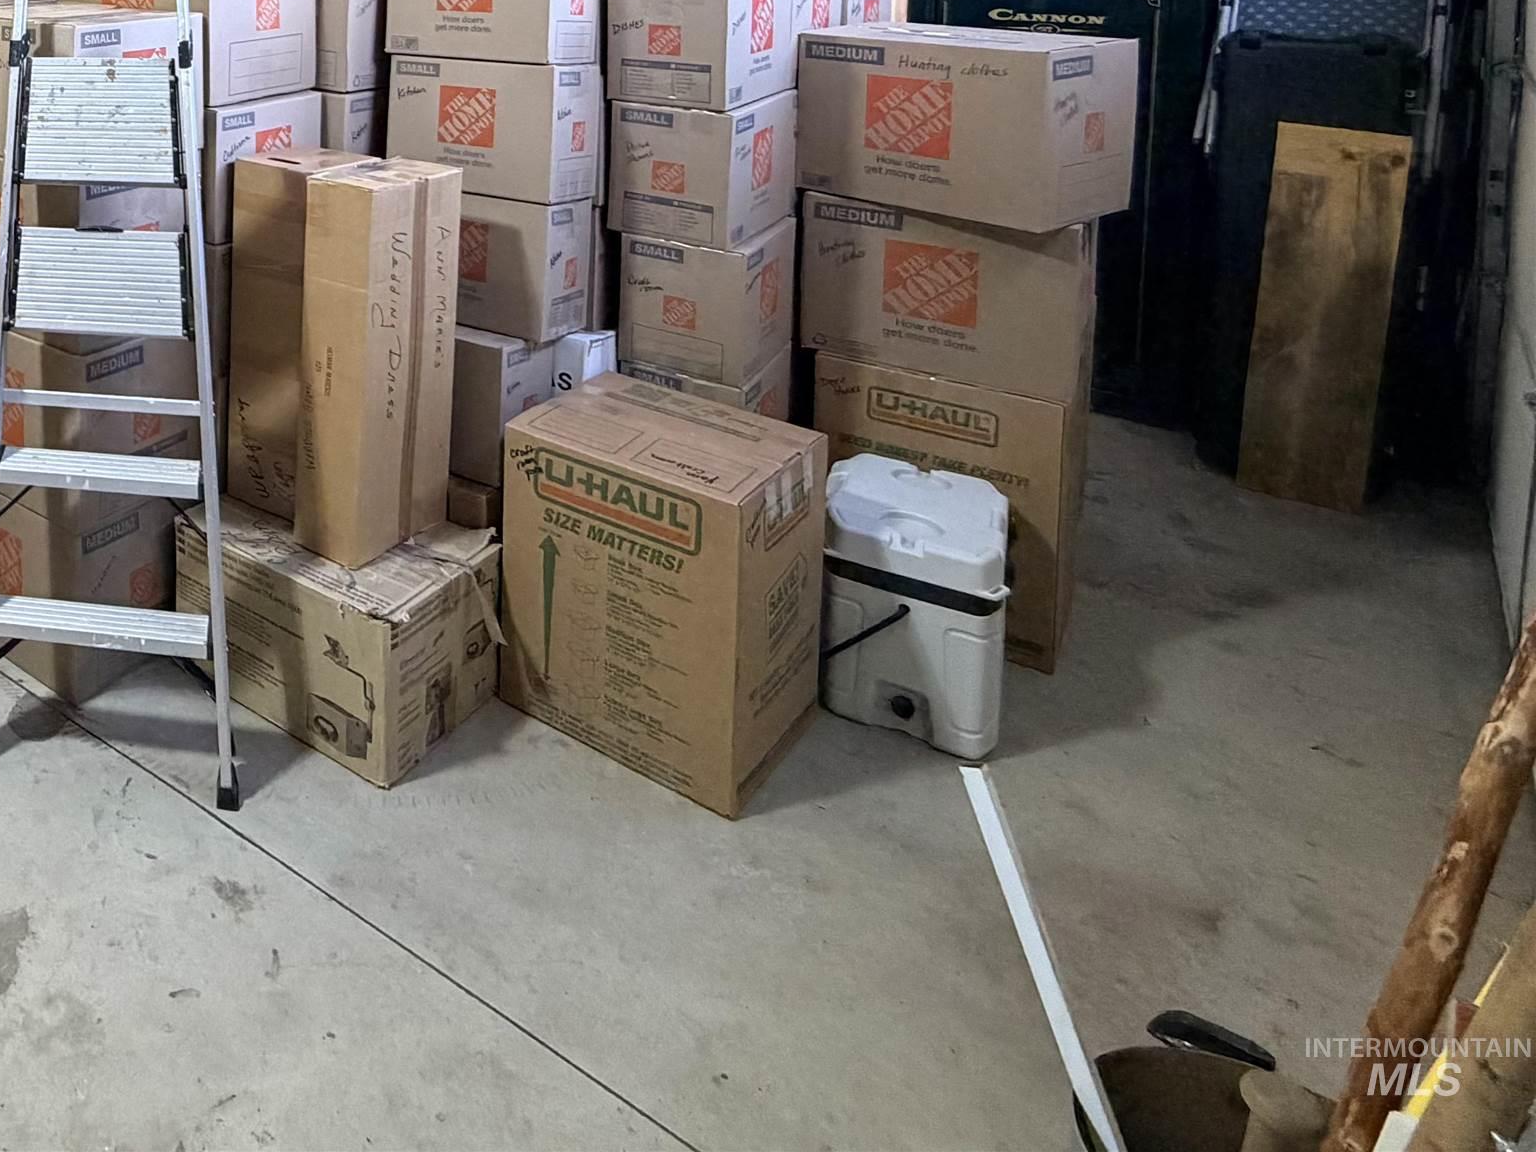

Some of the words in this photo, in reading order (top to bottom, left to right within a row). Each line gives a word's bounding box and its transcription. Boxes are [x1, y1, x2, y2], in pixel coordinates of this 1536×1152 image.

[613, 19, 645, 35] DISHES
[988, 8, 1107, 25] CANNON
[85, 32, 117, 45] SMALL
[812, 46, 878, 62] MEDIUM
[898, 54, 952, 79] Hunting
[400, 63, 435, 74] SMALL
[874, 85, 910, 111] THE
[225, 115, 252, 128] SMALL
[439, 88, 496, 142] HOME
[625, 110, 669, 125] SMALL
[865, 81, 953, 150] HOME
[897, 116, 952, 153] DEPOT
[821, 206, 895, 226] MEDIUM
[635, 244, 678, 260] SMALL
[896, 255, 928, 278] THE
[885, 252, 976, 314] HOME
[87, 348, 142, 379] MEDIUM
[876, 392, 992, 433] U-HAUL
[544, 458, 689, 531] U-HAUL
[85, 515, 138, 553] MEDIUM
[543, 508, 581, 534] SIZE
[587, 525, 685, 574] MATTERS!
